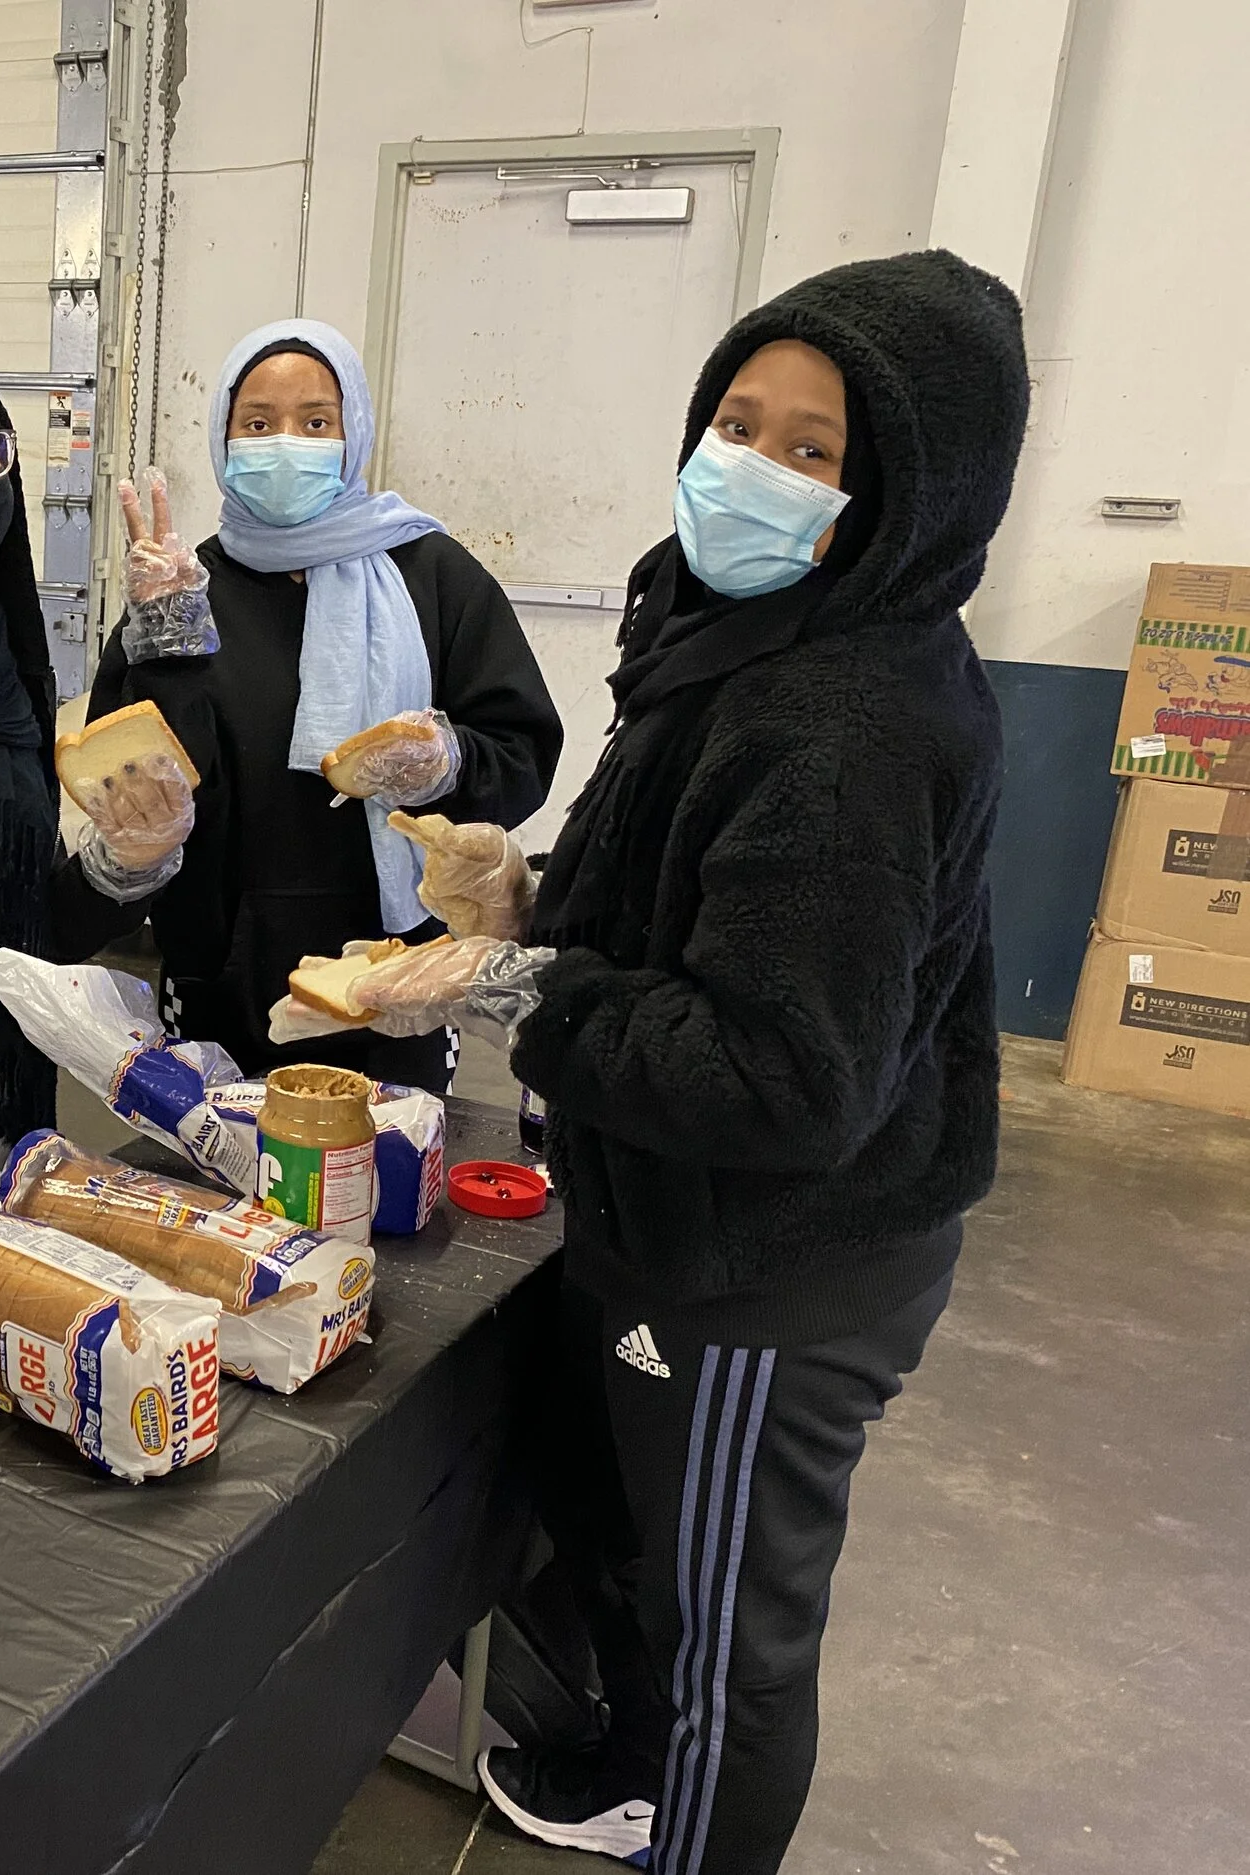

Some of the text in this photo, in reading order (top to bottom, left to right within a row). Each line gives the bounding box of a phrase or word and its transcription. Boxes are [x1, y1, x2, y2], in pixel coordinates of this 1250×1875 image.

[1149, 997, 1248, 1019] NEW DIRECTIONS
[321, 1306, 347, 1332] MRS
[615, 1344, 671, 1378] adidas
[166, 1349, 188, 1434] BAIRD'S
[139, 1398, 152, 1448] GREAT TASTE
